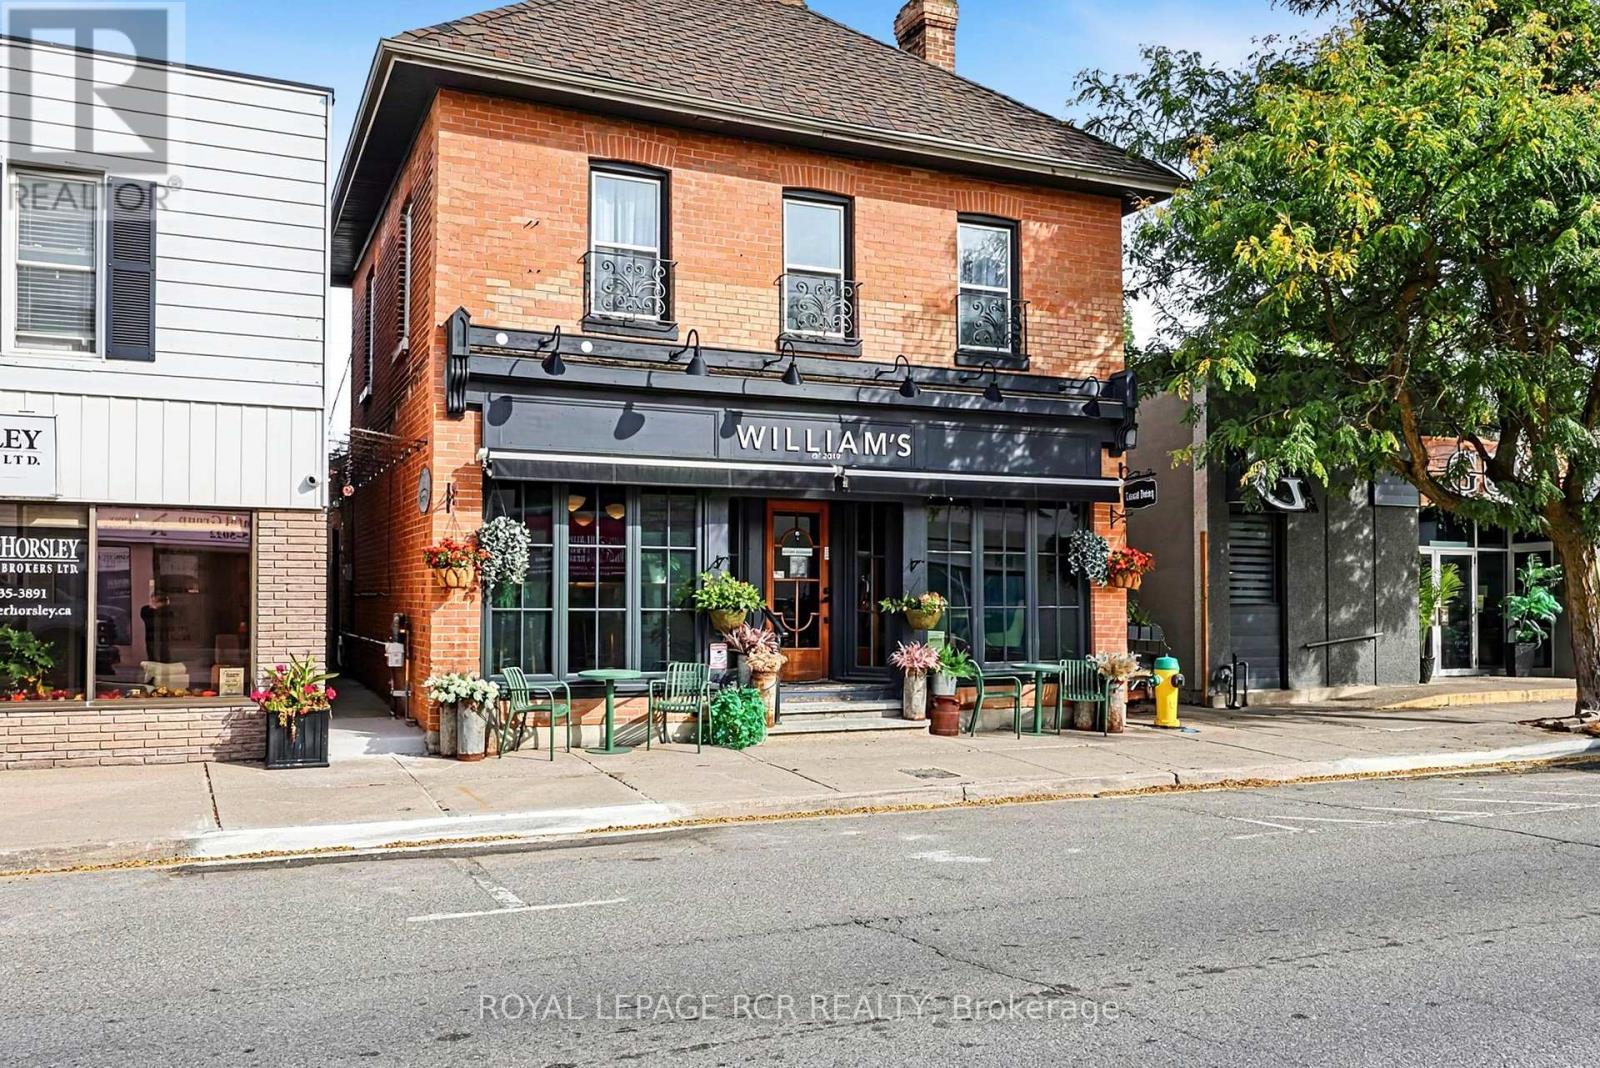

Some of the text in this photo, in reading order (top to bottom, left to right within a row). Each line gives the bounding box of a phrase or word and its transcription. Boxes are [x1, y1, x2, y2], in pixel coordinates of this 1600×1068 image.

[737, 424, 912, 457] WILLIAM'S
[0, 535, 80, 559] HORSLEY
[1, 562, 53, 573] BROKERS
